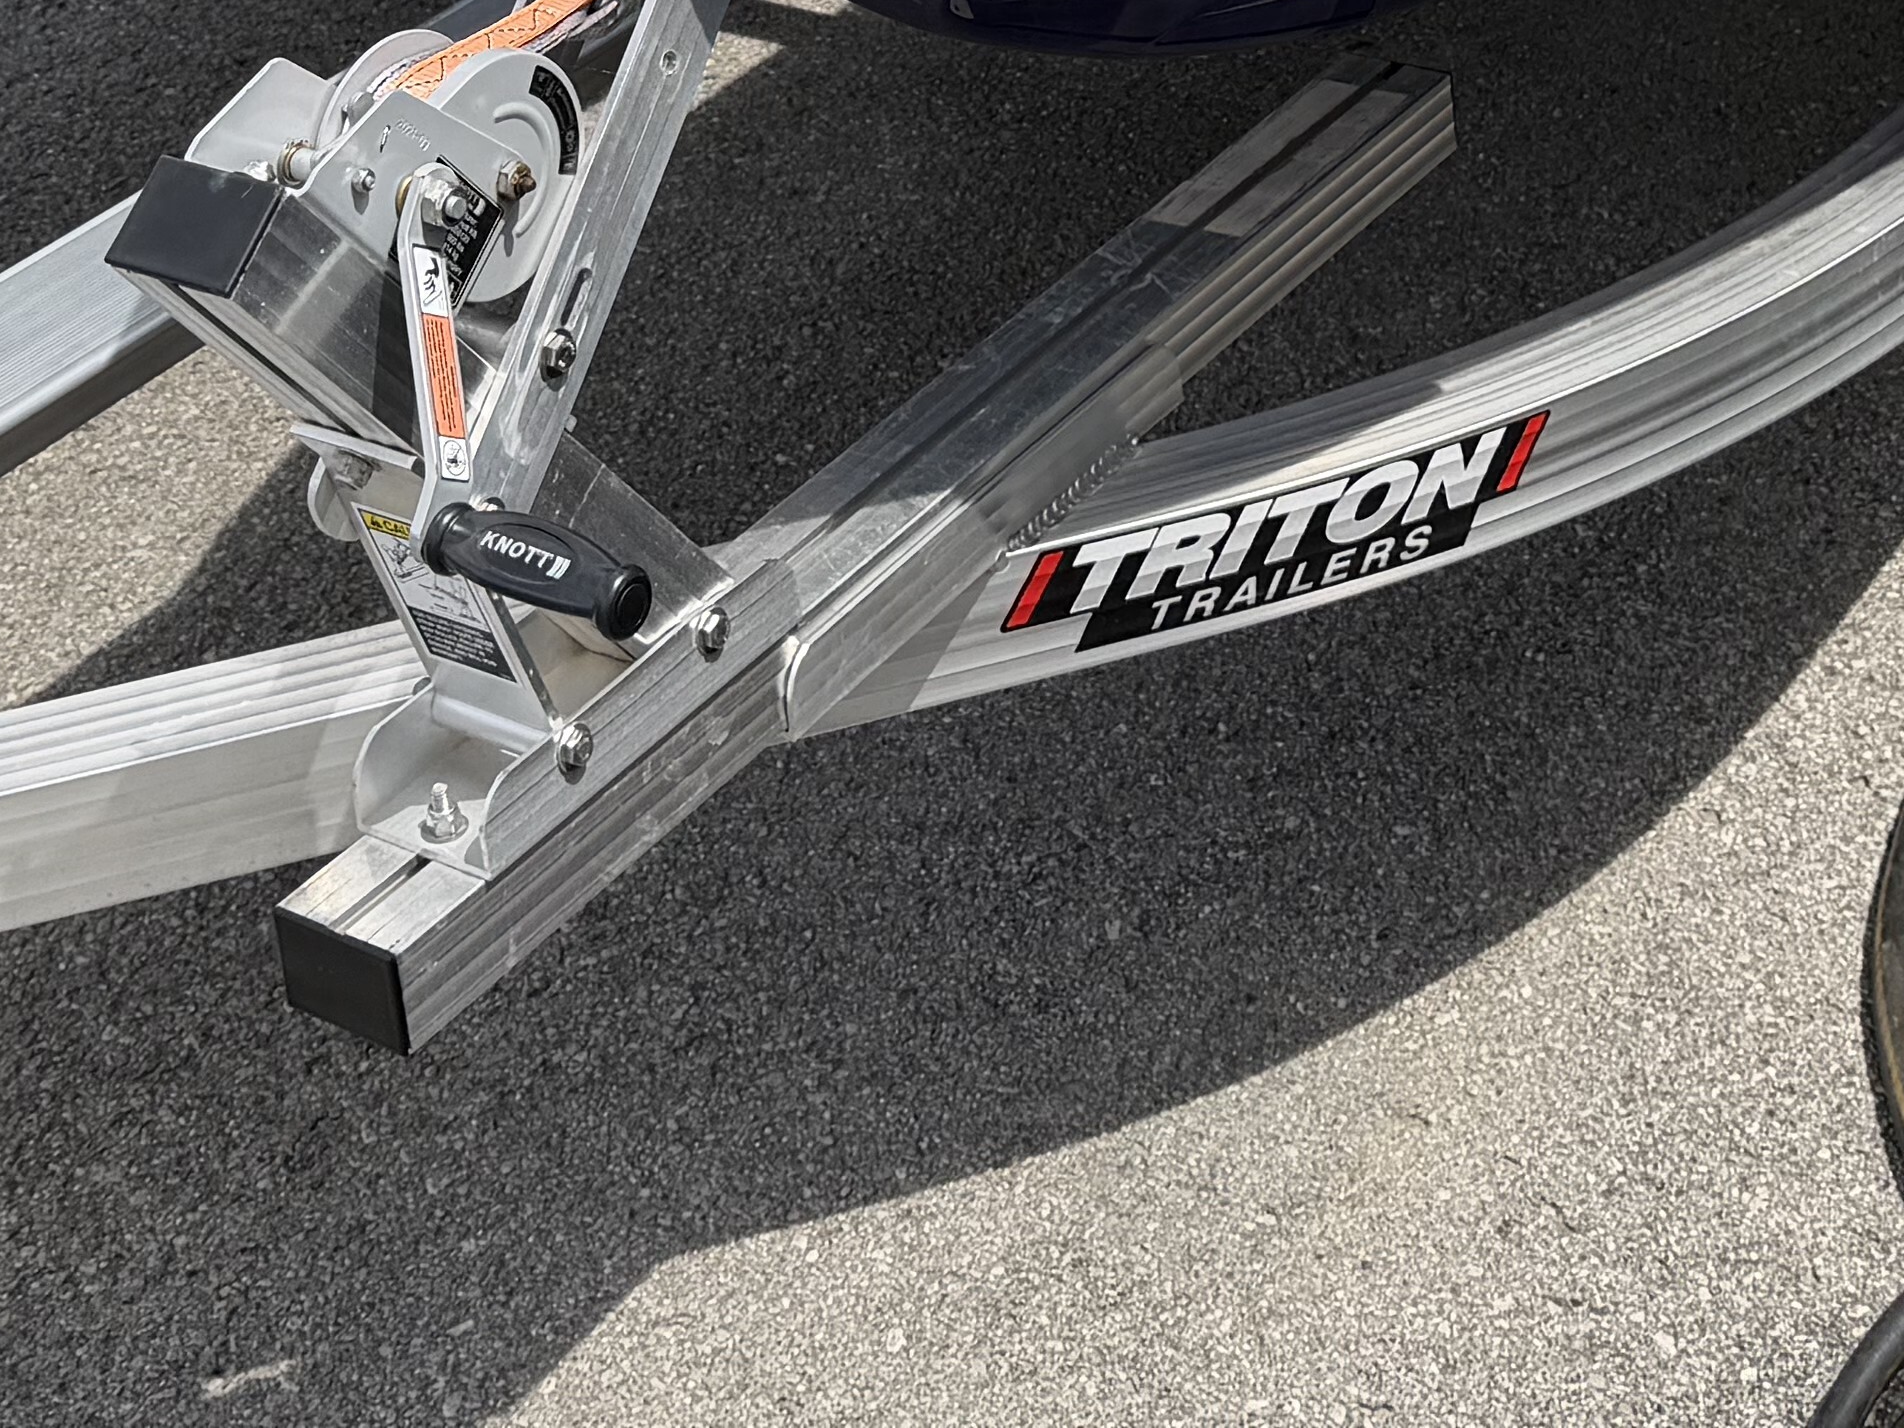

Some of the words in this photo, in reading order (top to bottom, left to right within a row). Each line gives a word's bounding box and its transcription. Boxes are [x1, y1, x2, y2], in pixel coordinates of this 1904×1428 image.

[479, 530, 555, 570] KNOTT
[1070, 425, 1507, 615] TRITON
[1150, 523, 1434, 632] TRAILERS
